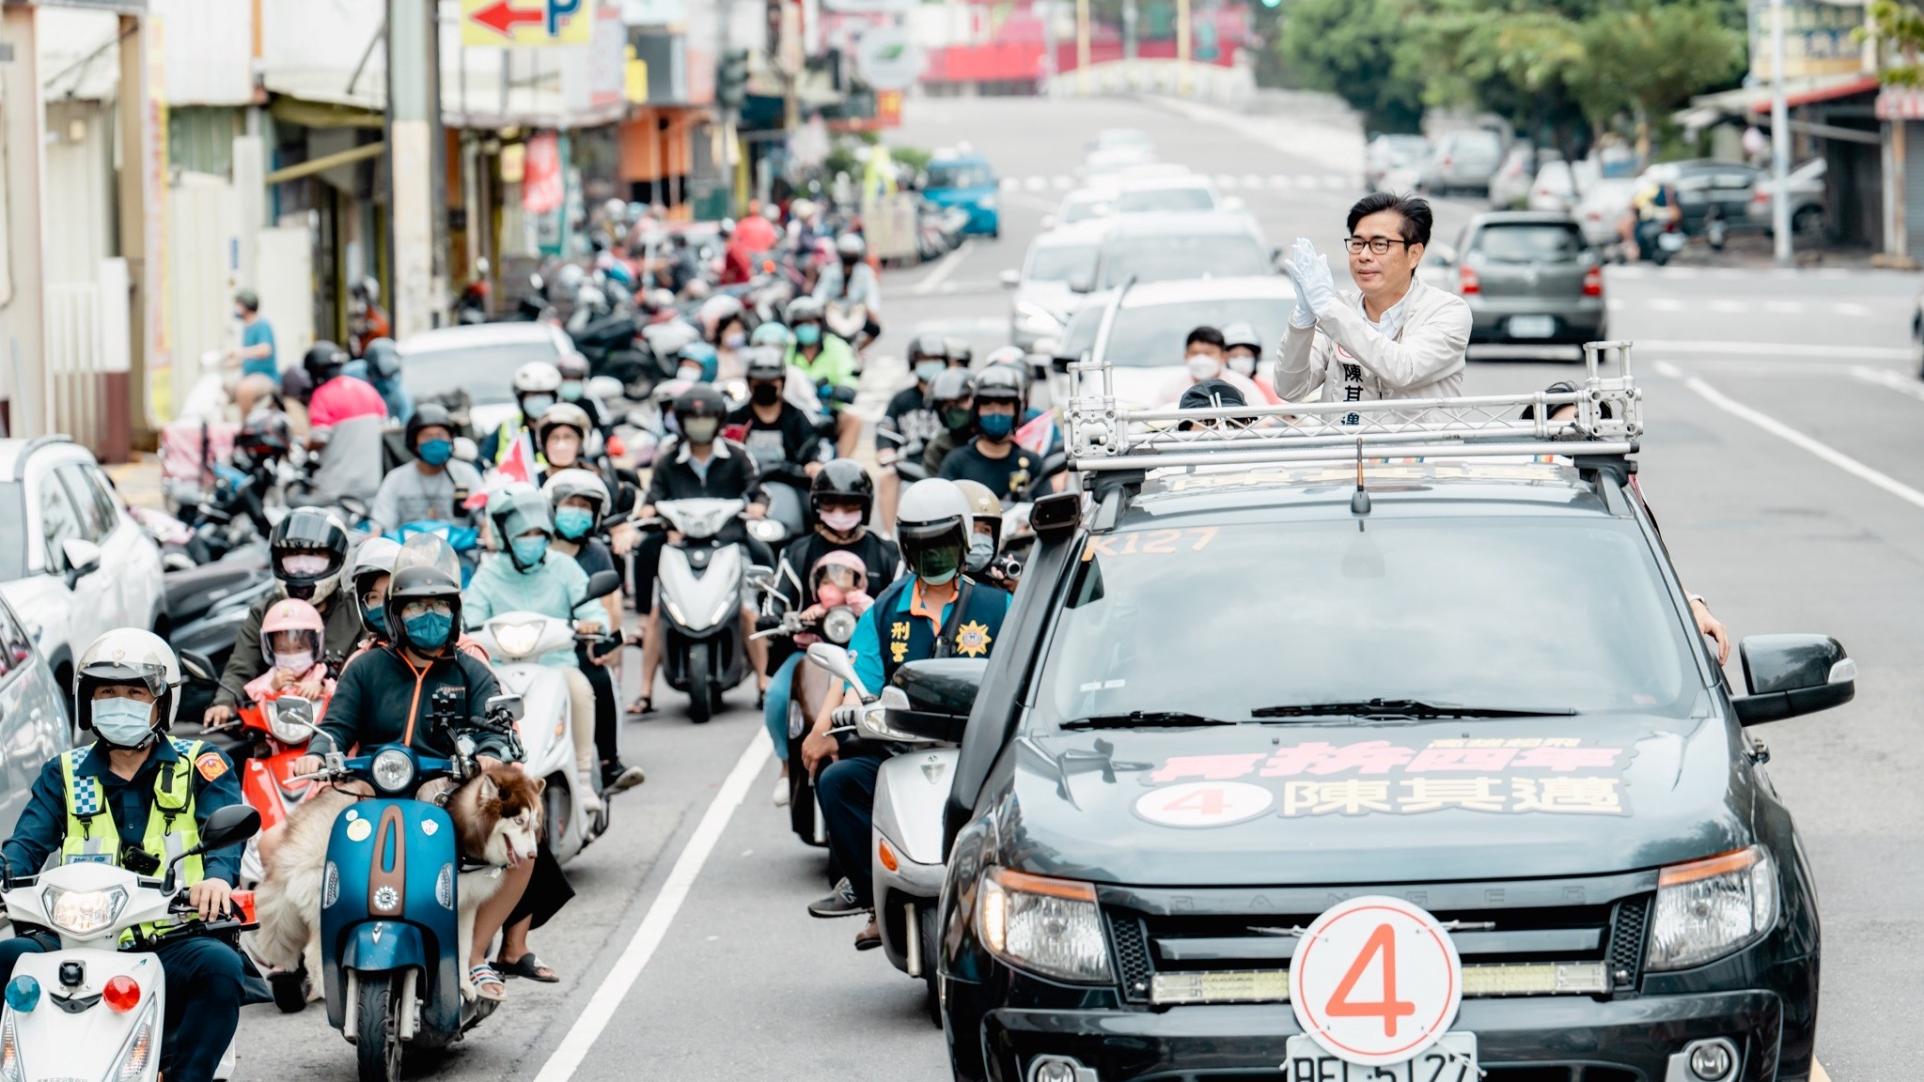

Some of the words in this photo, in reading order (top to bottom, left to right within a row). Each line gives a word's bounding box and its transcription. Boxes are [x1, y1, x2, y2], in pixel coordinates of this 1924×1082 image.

[890, 621, 910, 663] 刑警
[1162, 787, 1233, 816] 4
[1283, 776, 1622, 815] 陳其邁
[1325, 923, 1416, 1038] 4
